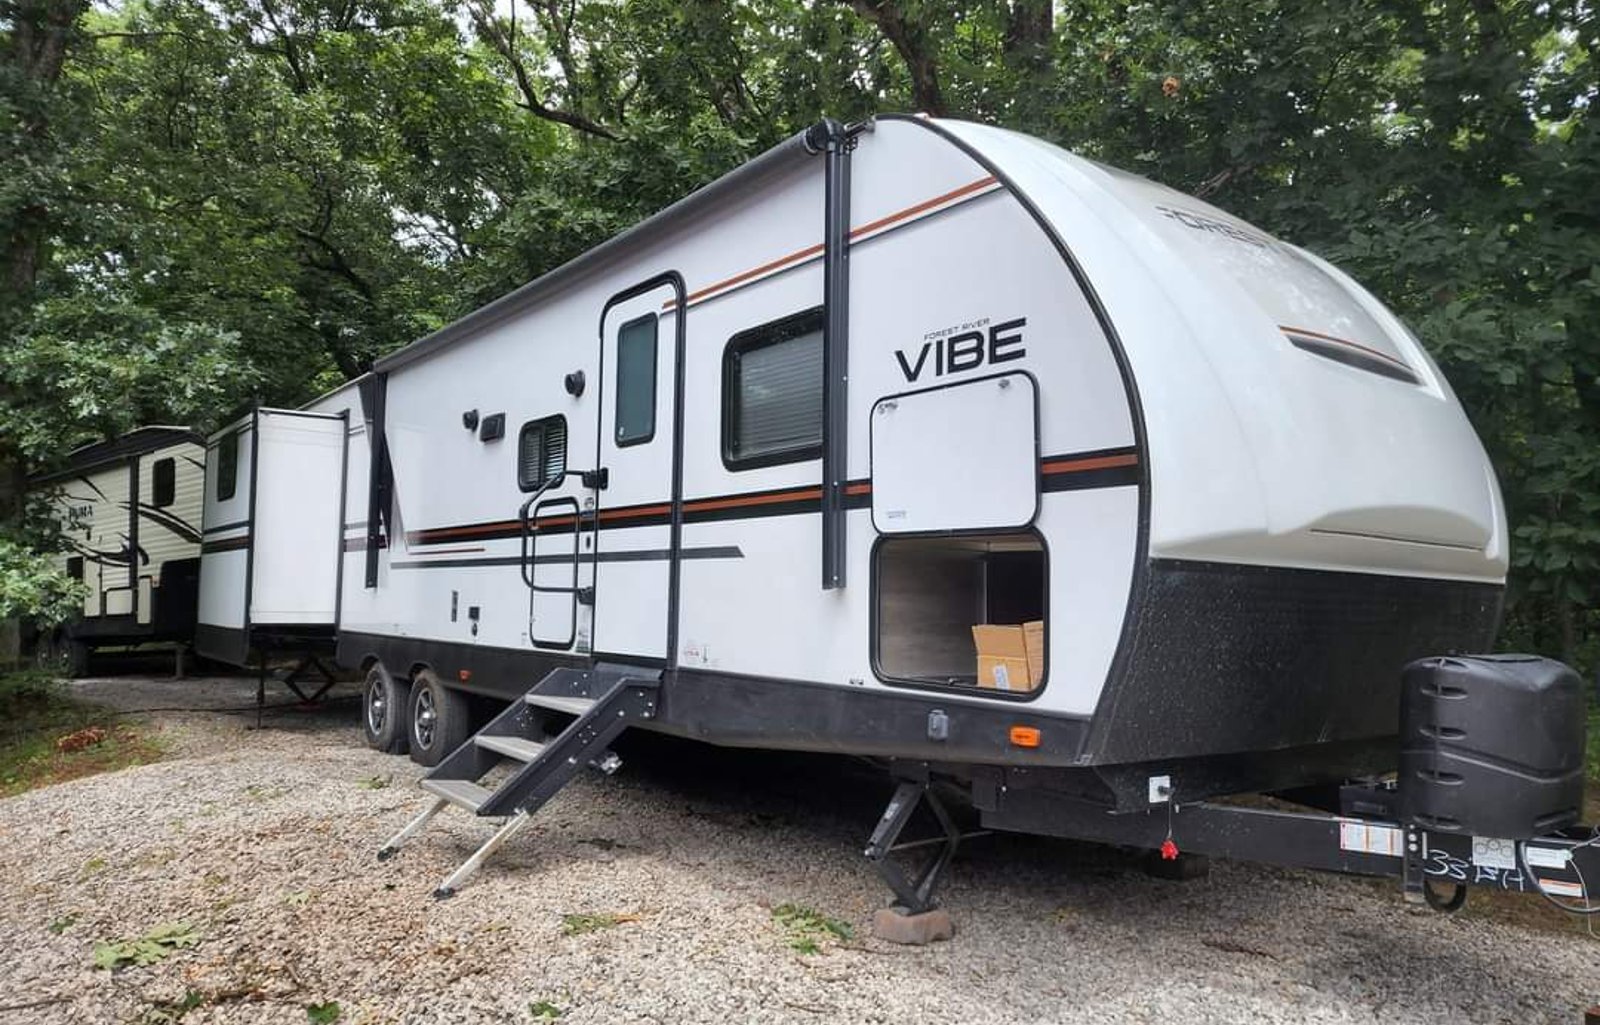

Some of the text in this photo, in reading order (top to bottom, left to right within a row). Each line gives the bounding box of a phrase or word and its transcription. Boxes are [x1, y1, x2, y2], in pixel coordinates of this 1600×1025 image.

[894, 316, 1027, 383] VIBE
[923, 317, 991, 340] FOREST RIVER
